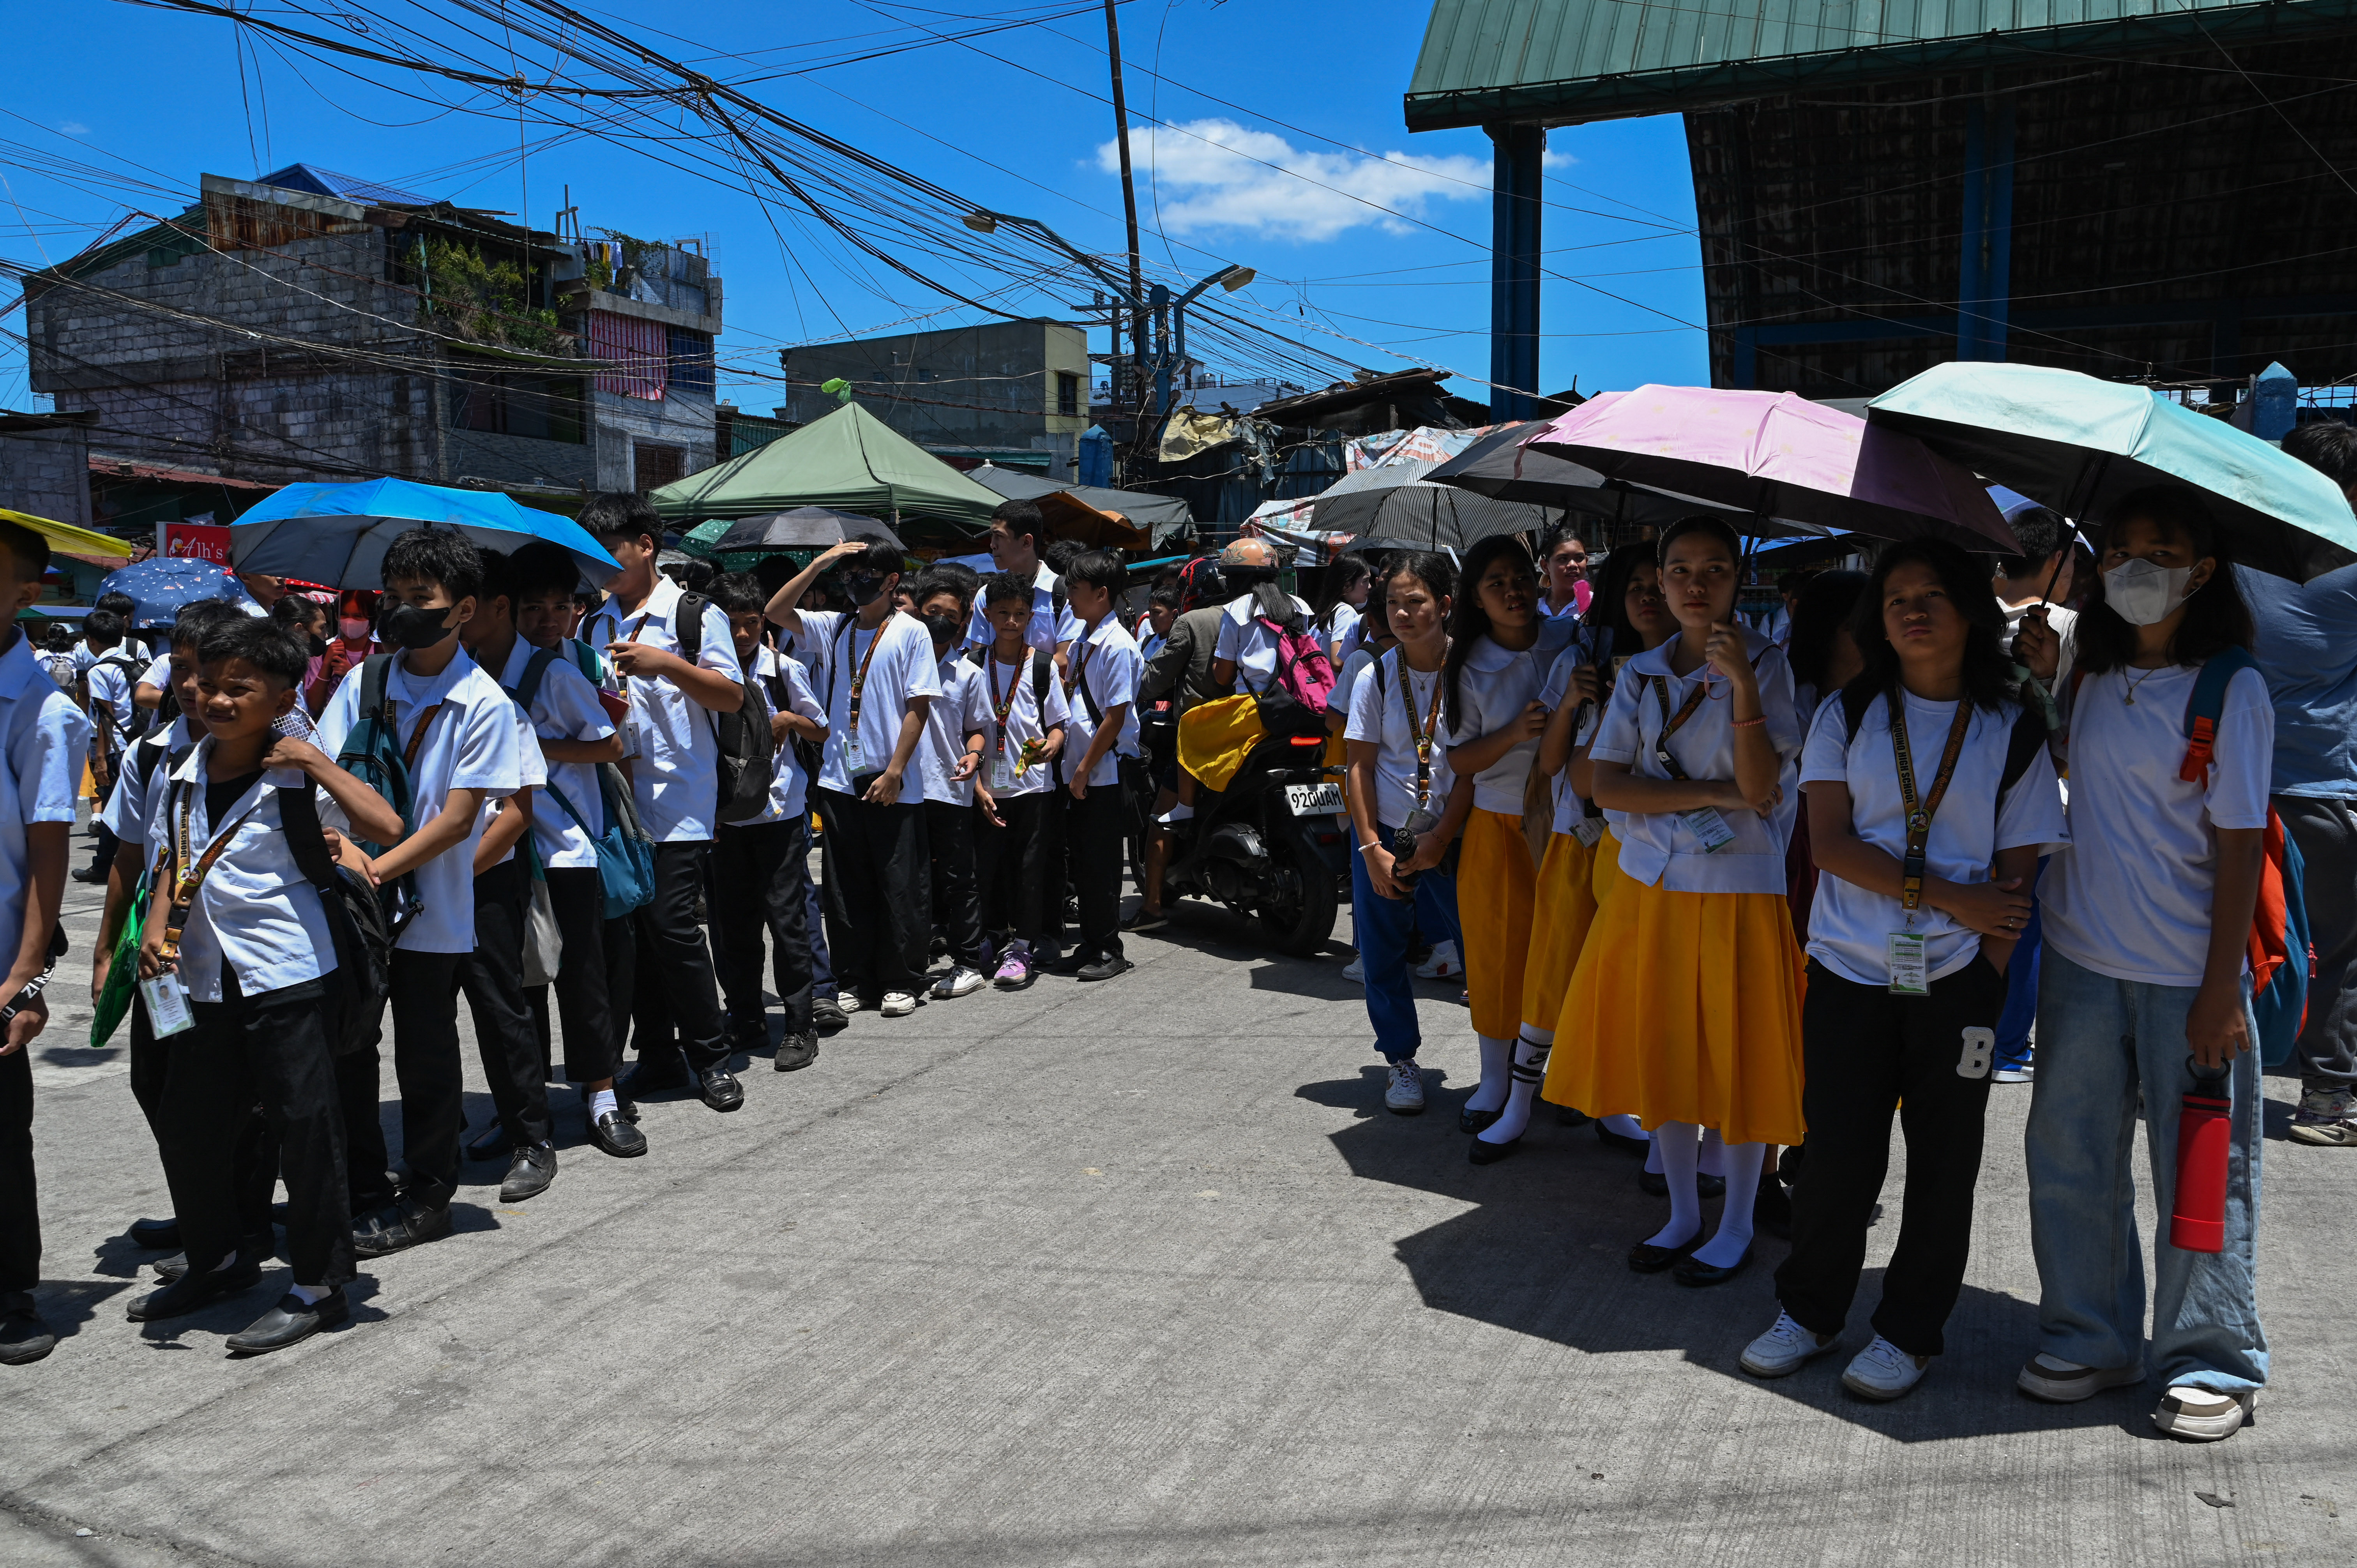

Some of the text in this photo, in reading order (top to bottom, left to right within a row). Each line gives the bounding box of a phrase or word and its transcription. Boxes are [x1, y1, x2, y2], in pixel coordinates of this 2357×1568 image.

[181, 147, 223, 169] Alh's
[1656, 684, 1666, 696] HIGH
[1402, 680, 1410, 698] AQUINO
[1408, 711, 1417, 732] SCHOOL
[1893, 723, 1914, 804] AQUINO HIGH SCHOOL
[1947, 742, 1958, 766] Greater
[1291, 790, 1342, 809] 920UAM
[1534, 1051, 1549, 1059] NIKE
[1956, 1026, 1995, 1079] B
